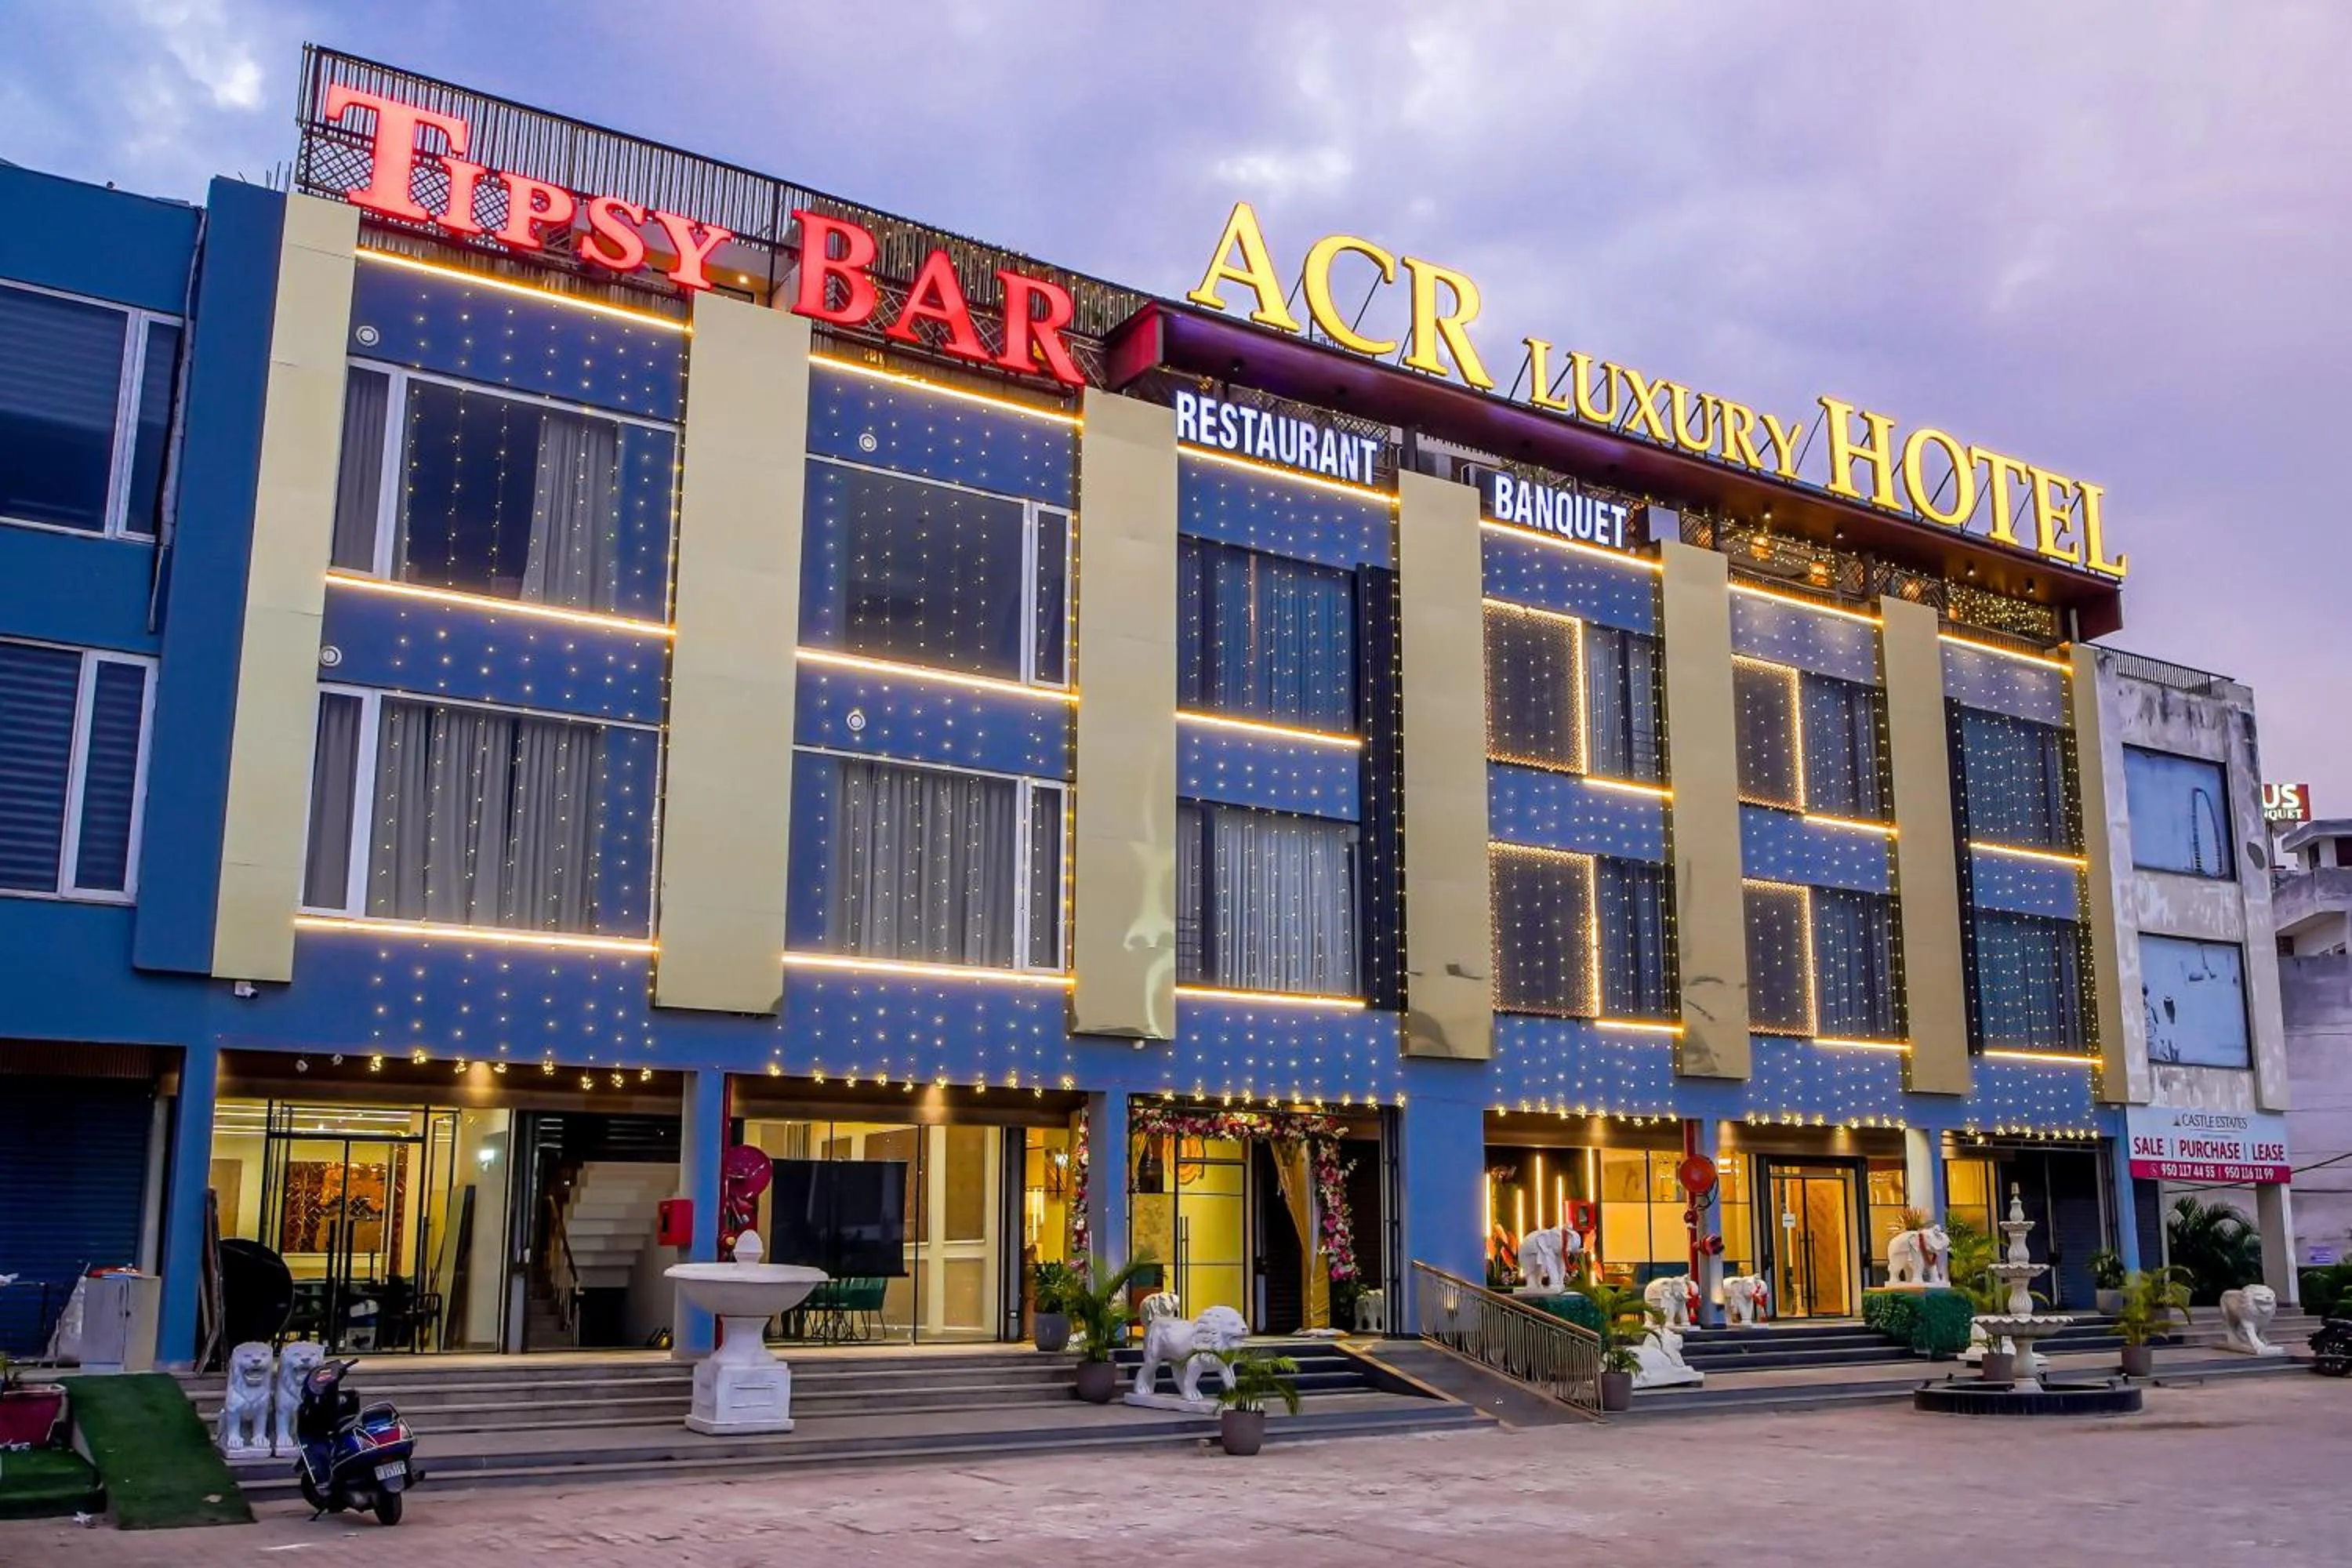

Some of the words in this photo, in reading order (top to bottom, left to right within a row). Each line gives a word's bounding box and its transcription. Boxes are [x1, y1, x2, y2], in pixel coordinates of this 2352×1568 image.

[325, 83, 735, 289] TIPSY
[792, 209, 1085, 386] BAR
[1187, 201, 1494, 390] ACR
[1523, 337, 1802, 479] LUXURY
[1817, 396, 2128, 578] HOTEL
[1177, 390, 1377, 485] RESTAURANT
[1494, 474, 1627, 548] BANQUET
[2133, 1137, 2164, 1156] SALE
[2180, 1139, 2241, 1160] PURCHASE
[2252, 1143, 2285, 1161] LEASE
[2182, 1112, 2215, 1128] CASTLE
[2216, 1116, 2248, 1129] ESTATES
[2194, 1165, 2204, 1178] 44
